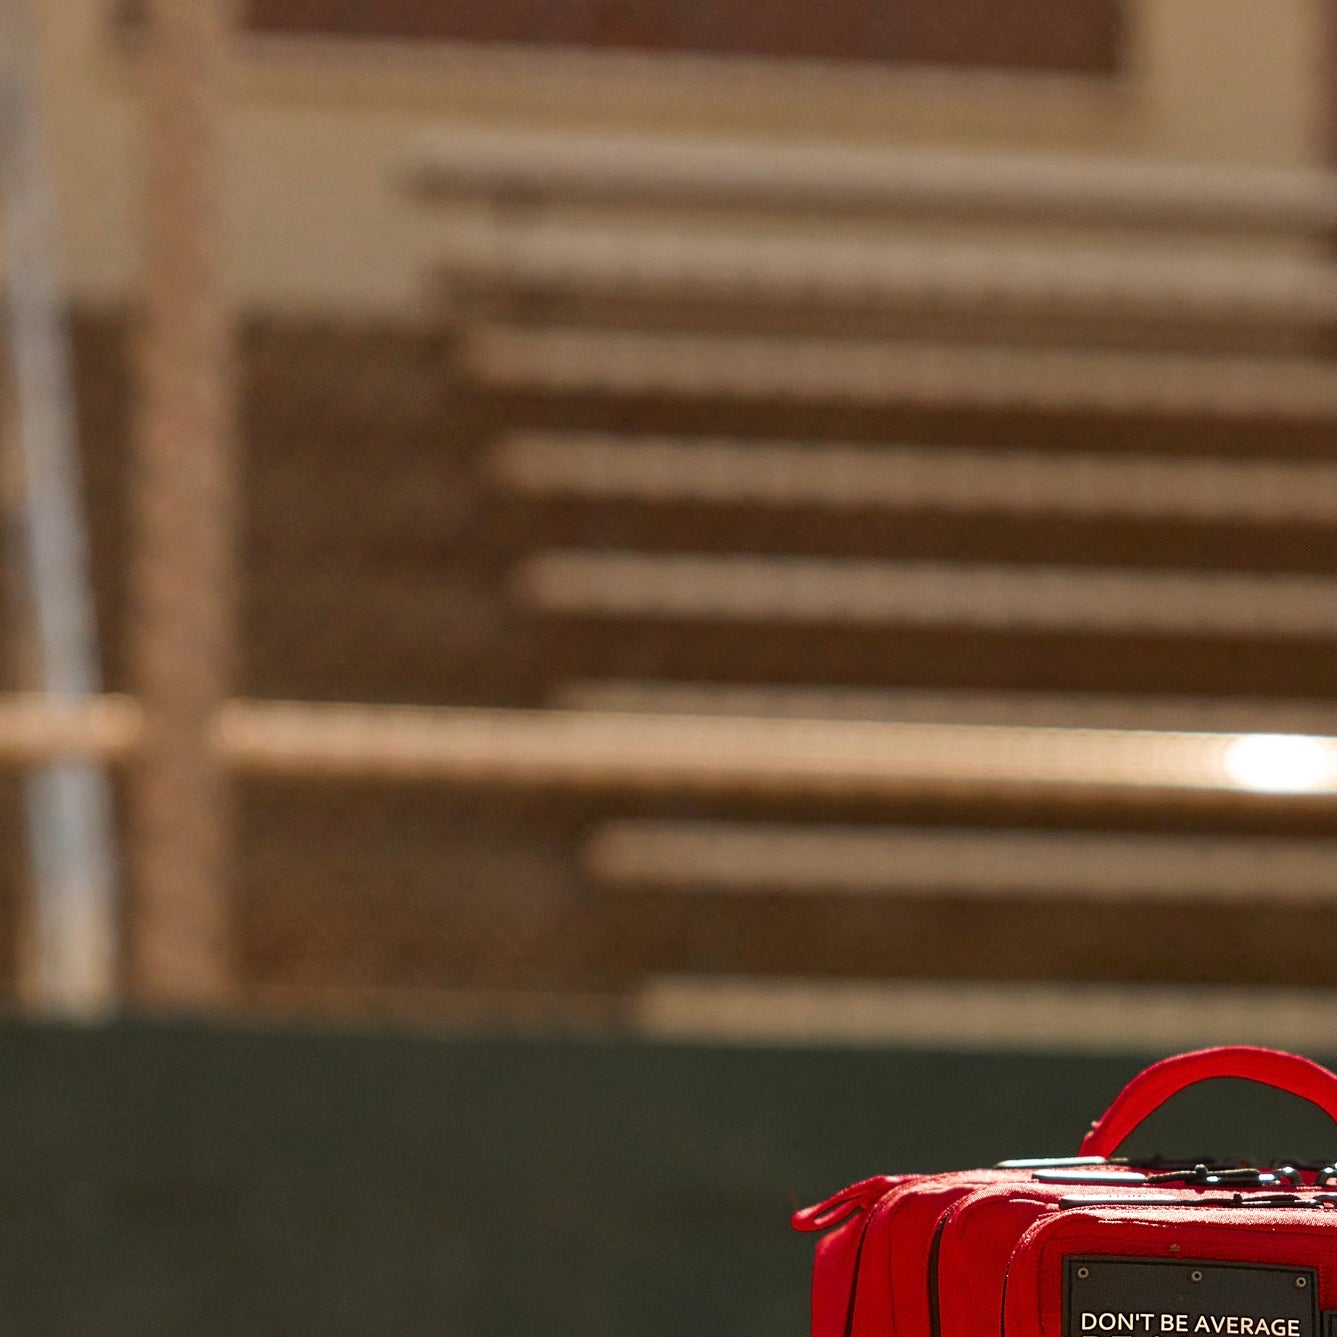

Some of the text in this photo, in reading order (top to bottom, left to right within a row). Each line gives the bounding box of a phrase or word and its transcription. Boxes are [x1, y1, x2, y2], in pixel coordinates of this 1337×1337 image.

[1081, 1312, 1301, 1337] DON'T BE AVERAGE
